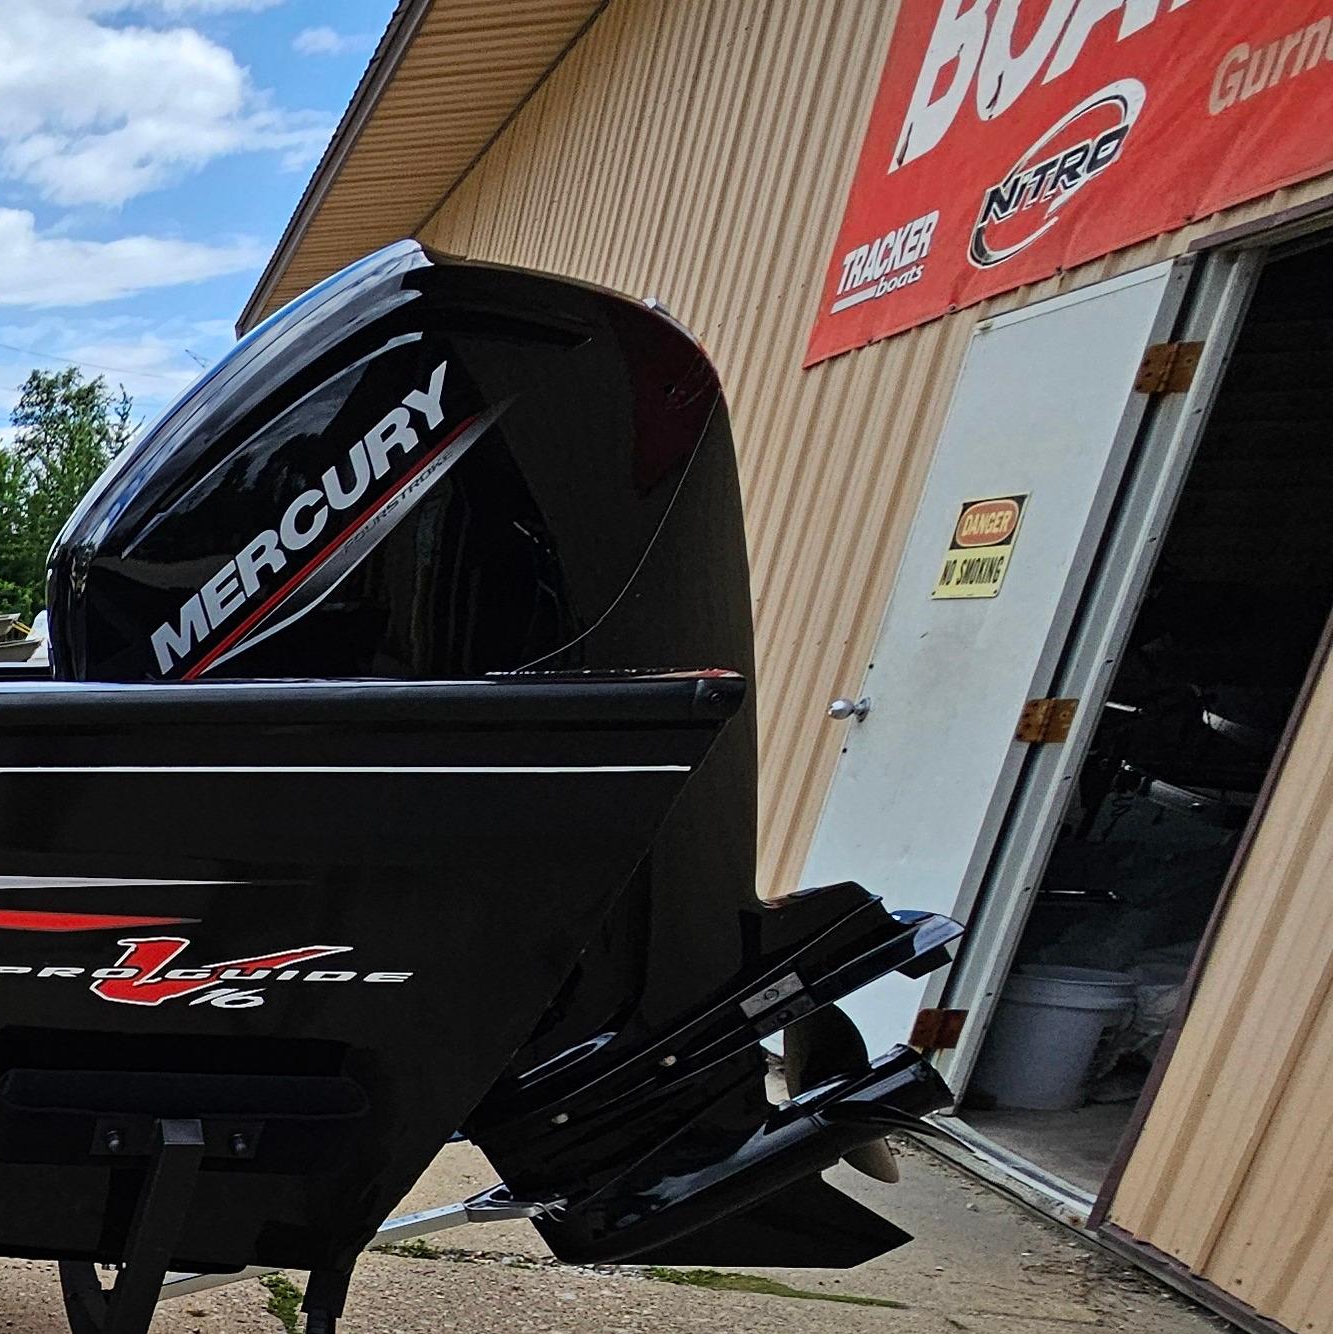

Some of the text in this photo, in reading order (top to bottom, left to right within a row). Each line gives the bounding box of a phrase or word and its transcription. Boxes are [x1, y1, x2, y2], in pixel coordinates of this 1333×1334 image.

[1208, 15, 1333, 116] Gurn
[979, 124, 1130, 226] NITRO
[836, 210, 940, 296] TRACKER
[874, 264, 925, 298] boats
[150, 360, 447, 675] MERCURY
[342, 450, 453, 554] FOURSTROKE
[961, 510, 1013, 537] DANGER
[939, 556, 1005, 586] NO SMOKING
[164, 967, 414, 983] GUIDE
[189, 986, 267, 1009] 16
